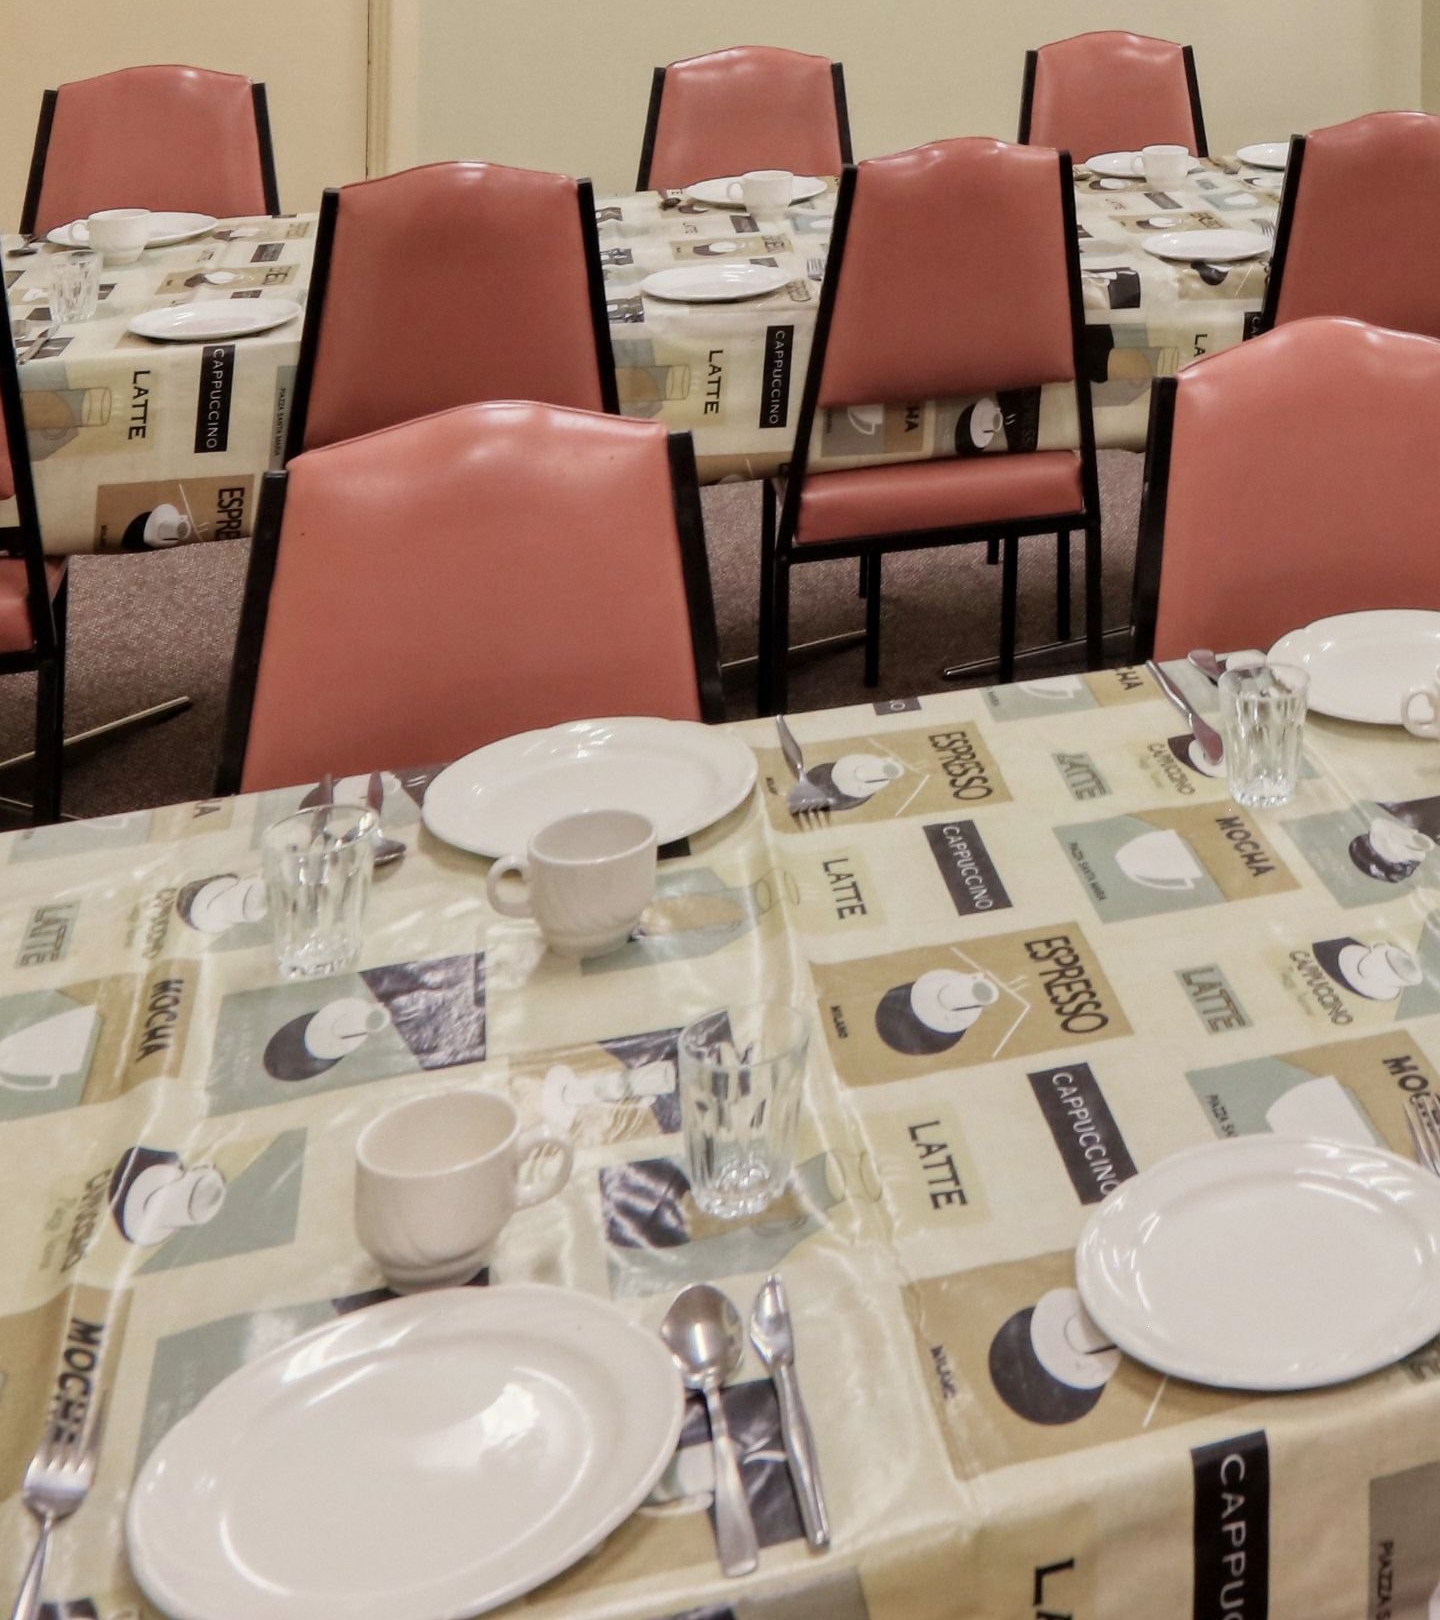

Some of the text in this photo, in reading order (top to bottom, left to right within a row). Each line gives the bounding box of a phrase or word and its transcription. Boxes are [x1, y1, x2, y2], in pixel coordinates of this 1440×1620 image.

[127, 370, 151, 440] LATTE
[205, 348, 226, 450] CAPPUCCINO
[704, 349, 723, 415] LATTE
[768, 329, 786, 425] CAPPUCCINO
[215, 486, 245, 540] ESPRE
[928, 731, 993, 801] ESPRESSO
[942, 825, 994, 910] CAPPUCCINO
[1214, 815, 1276, 878] MOCHA
[822, 857, 868, 920] LATTE
[1024, 935, 1109, 1034] ESPRESSO
[1182, 967, 1246, 1033] LATTE
[135, 979, 184, 1064] MOCHA
[907, 1120, 968, 1209] LATTE
